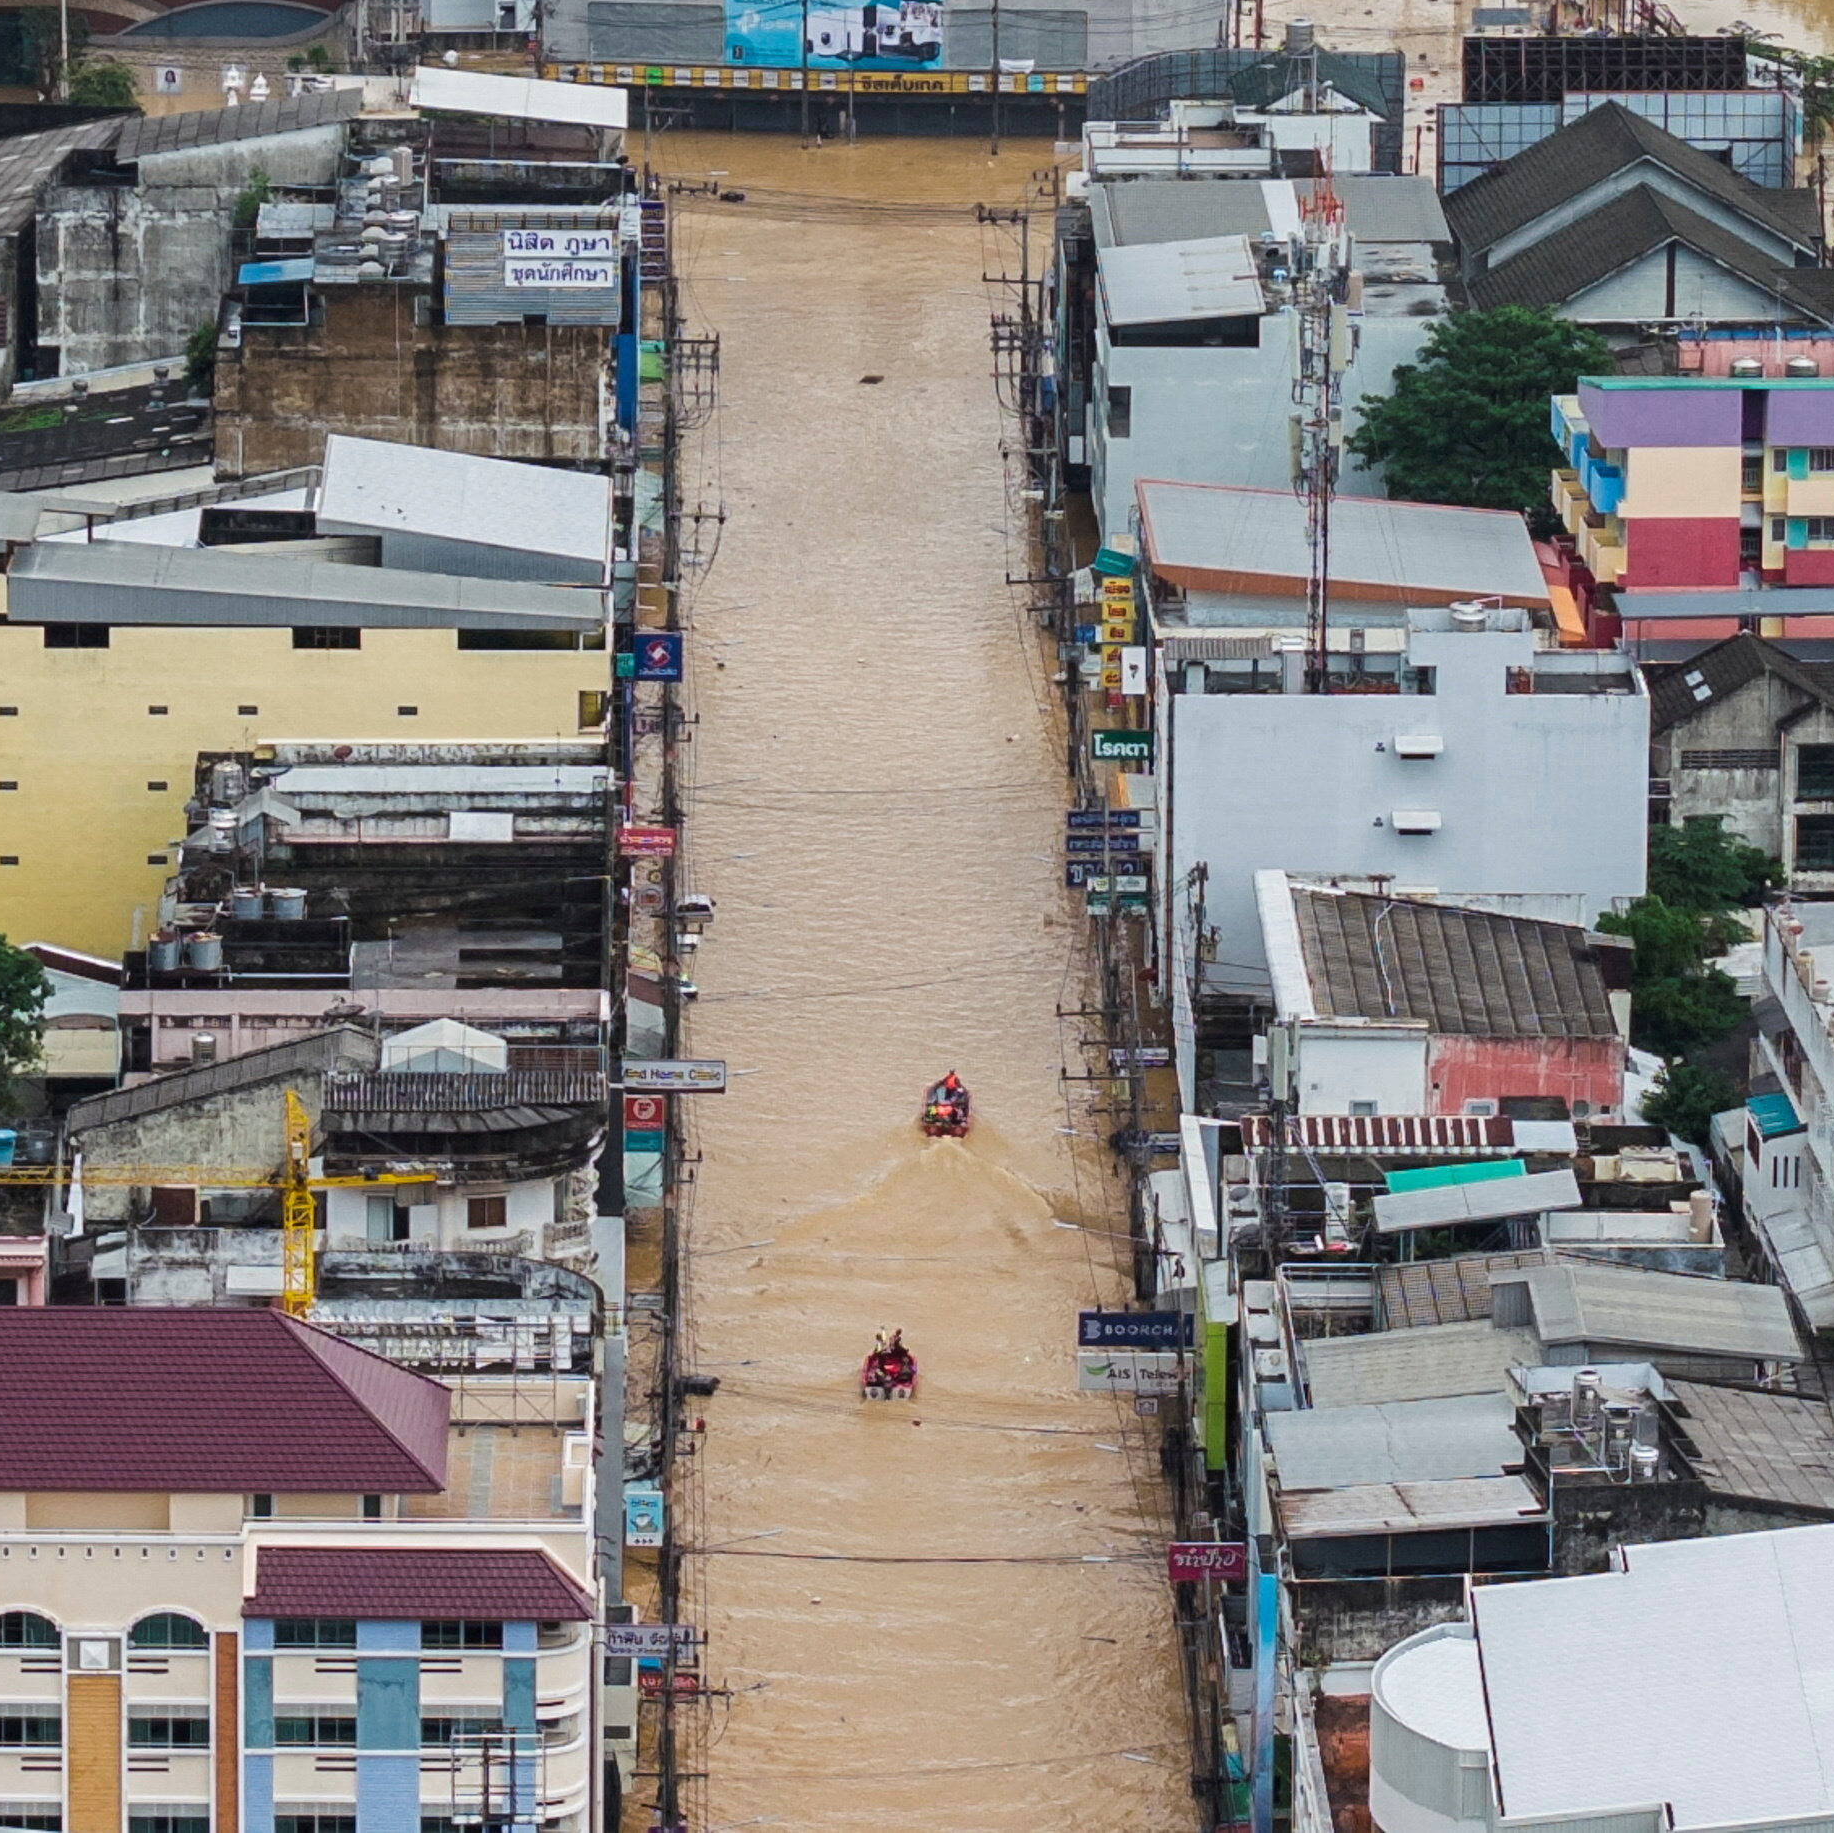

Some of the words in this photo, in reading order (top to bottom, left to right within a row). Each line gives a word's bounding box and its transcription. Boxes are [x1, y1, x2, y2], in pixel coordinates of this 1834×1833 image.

[508, 231, 555, 250] นิสิต
[564, 237, 609, 256] ภูษา
[511, 262, 609, 286] ชุดนักศึกษา
[1094, 733, 1149, 757] โรคตา
[1108, 1368, 1131, 1380] AIS
